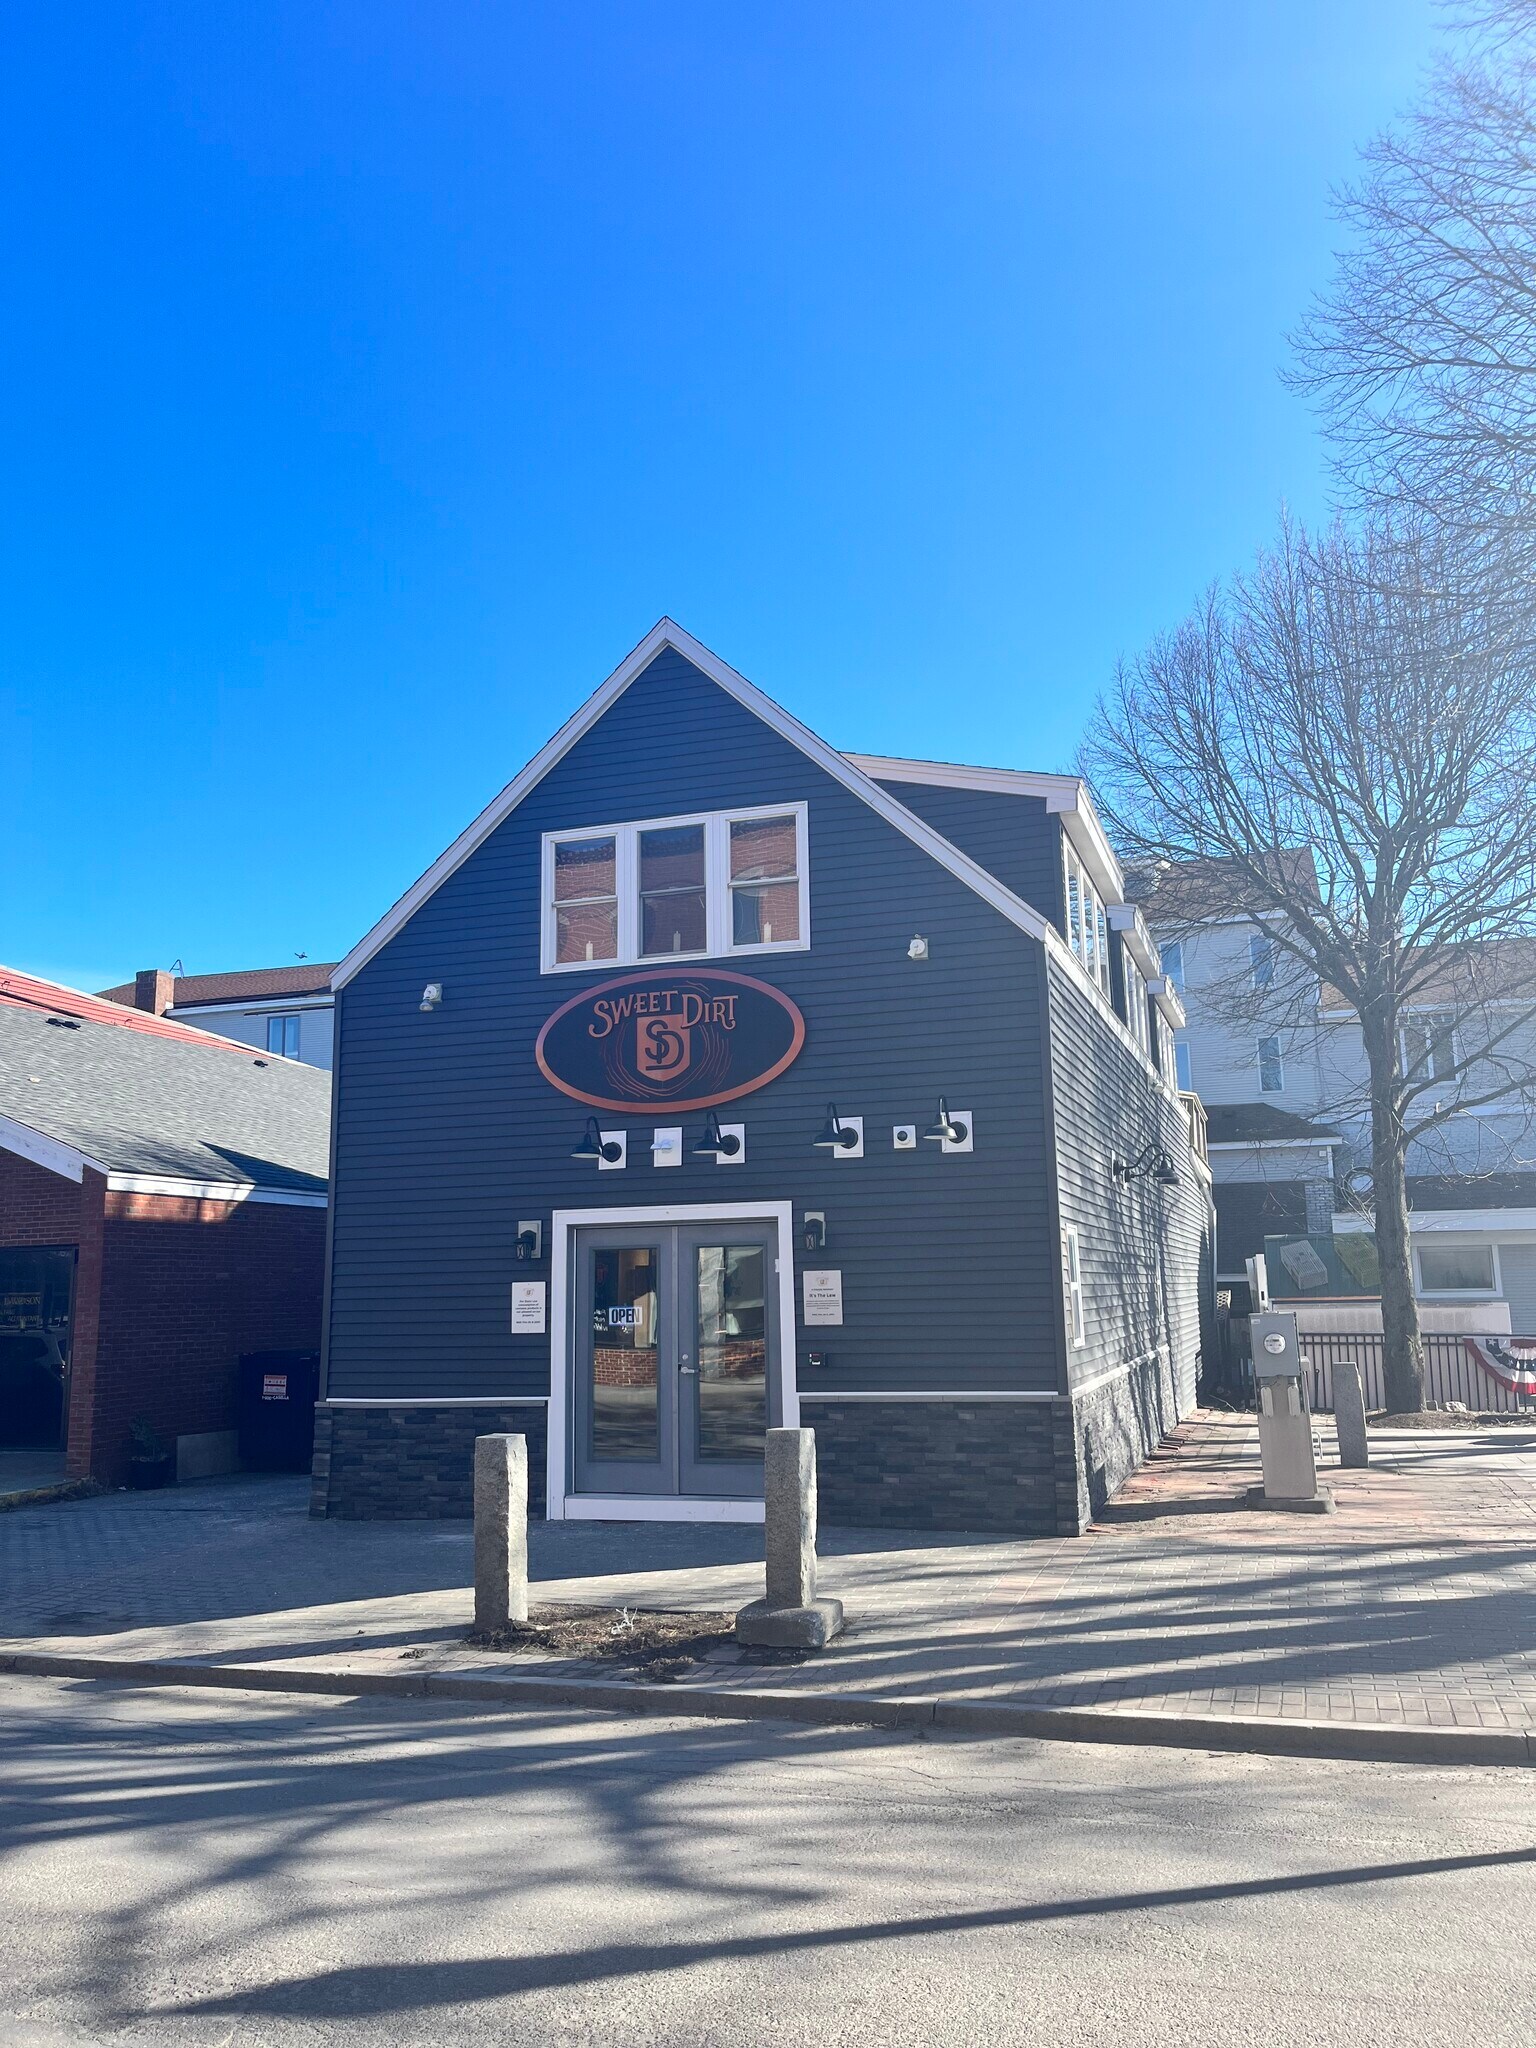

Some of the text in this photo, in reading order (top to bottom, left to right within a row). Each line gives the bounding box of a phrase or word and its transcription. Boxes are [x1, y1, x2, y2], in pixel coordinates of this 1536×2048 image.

[588, 990, 739, 1038] SWEET DIRT
[611, 1308, 640, 1324] OPEN
